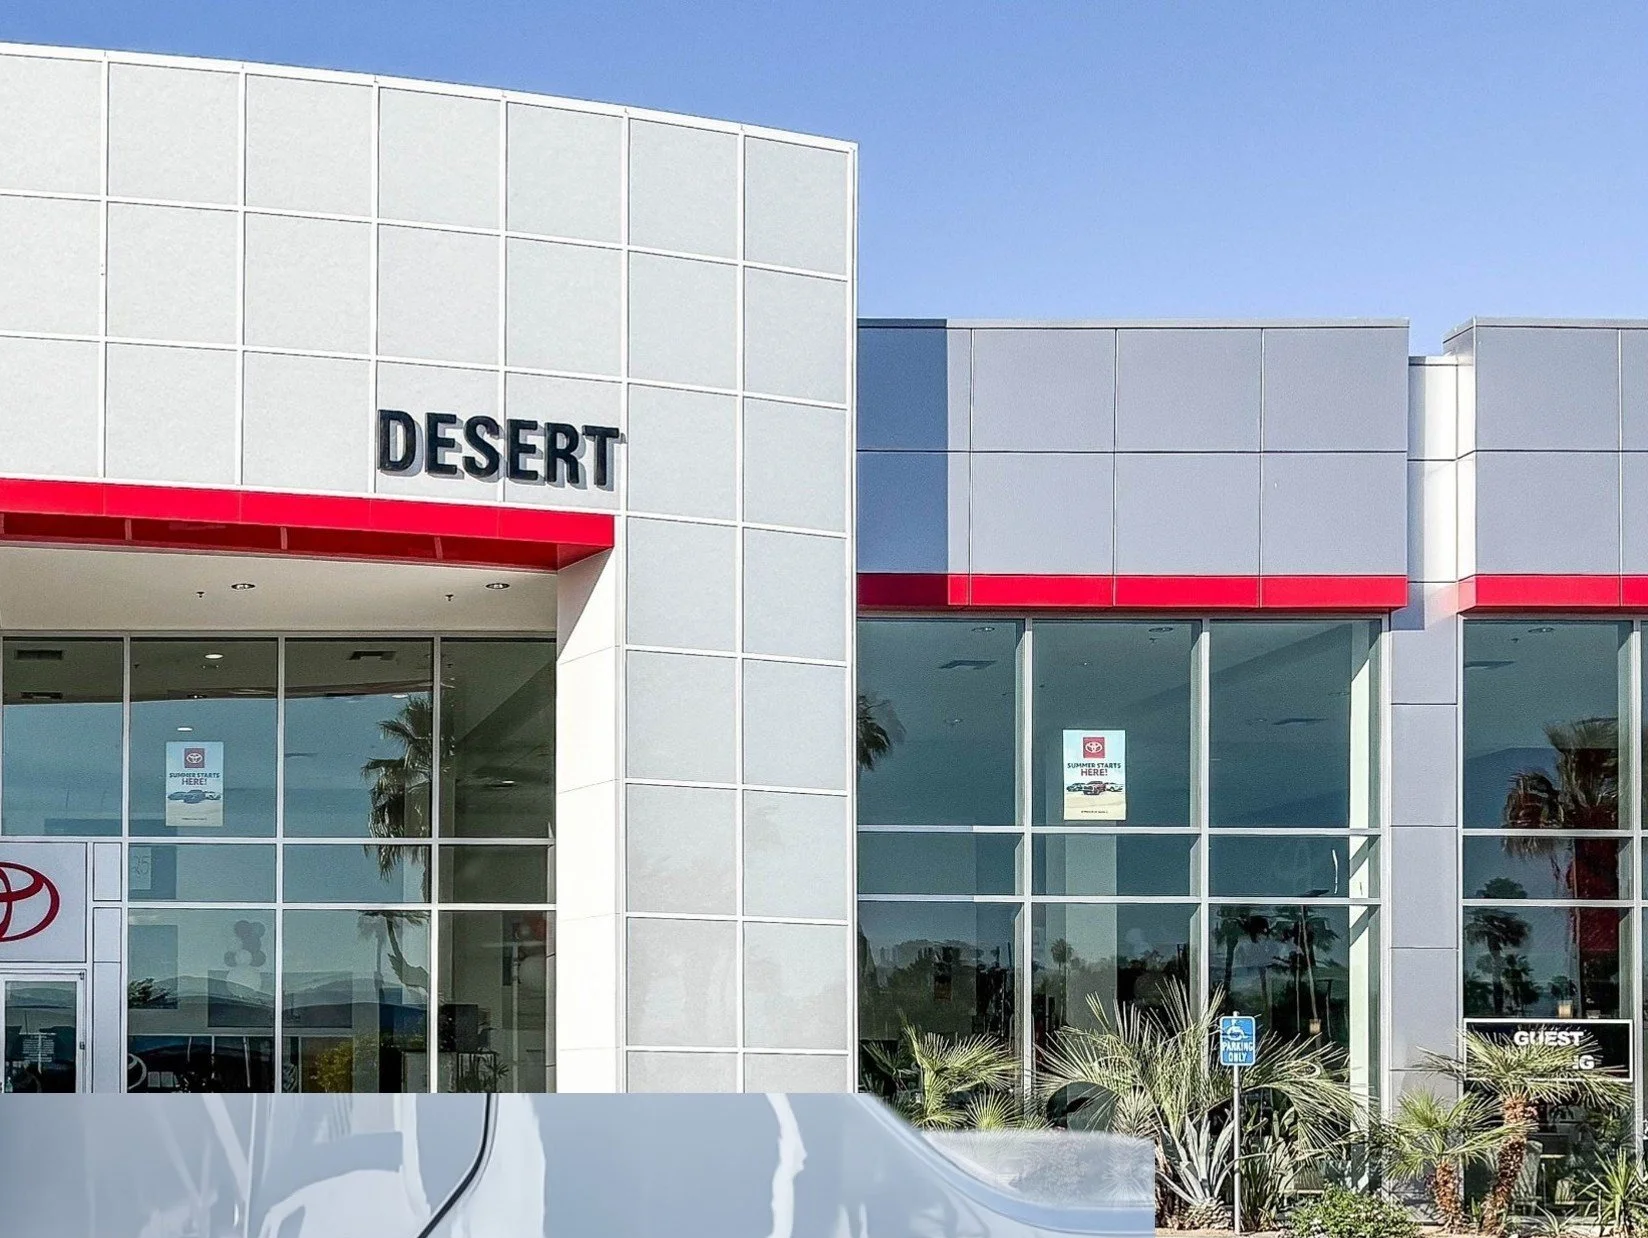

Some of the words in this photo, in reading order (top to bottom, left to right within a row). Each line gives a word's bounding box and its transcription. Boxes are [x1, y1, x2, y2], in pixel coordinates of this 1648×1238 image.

[376, 409, 620, 487] DESERT
[1081, 768, 1108, 776] HERE!
[182, 778, 207, 786] HERE!
[1513, 1031, 1584, 1046] GUEST
[1222, 1041, 1253, 1052] PARKING
[1228, 1052, 1247, 1062] ONLY
